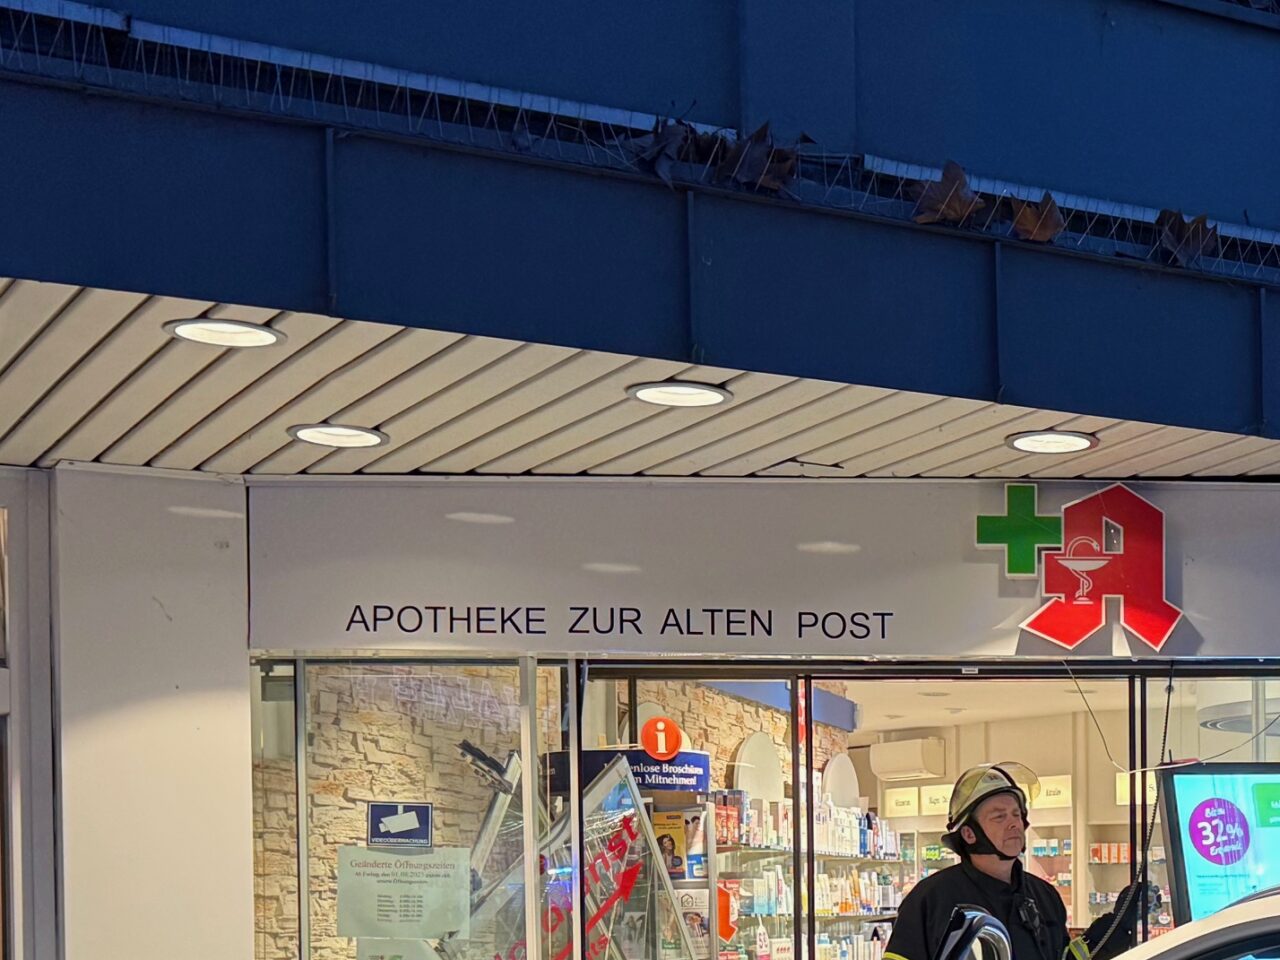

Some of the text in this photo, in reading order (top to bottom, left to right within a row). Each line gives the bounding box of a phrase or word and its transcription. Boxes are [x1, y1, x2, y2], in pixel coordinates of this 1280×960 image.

[346, 604, 894, 640] APOTHEKE ZUR ALTEN POST
[1197, 818, 1244, 846] 32%
